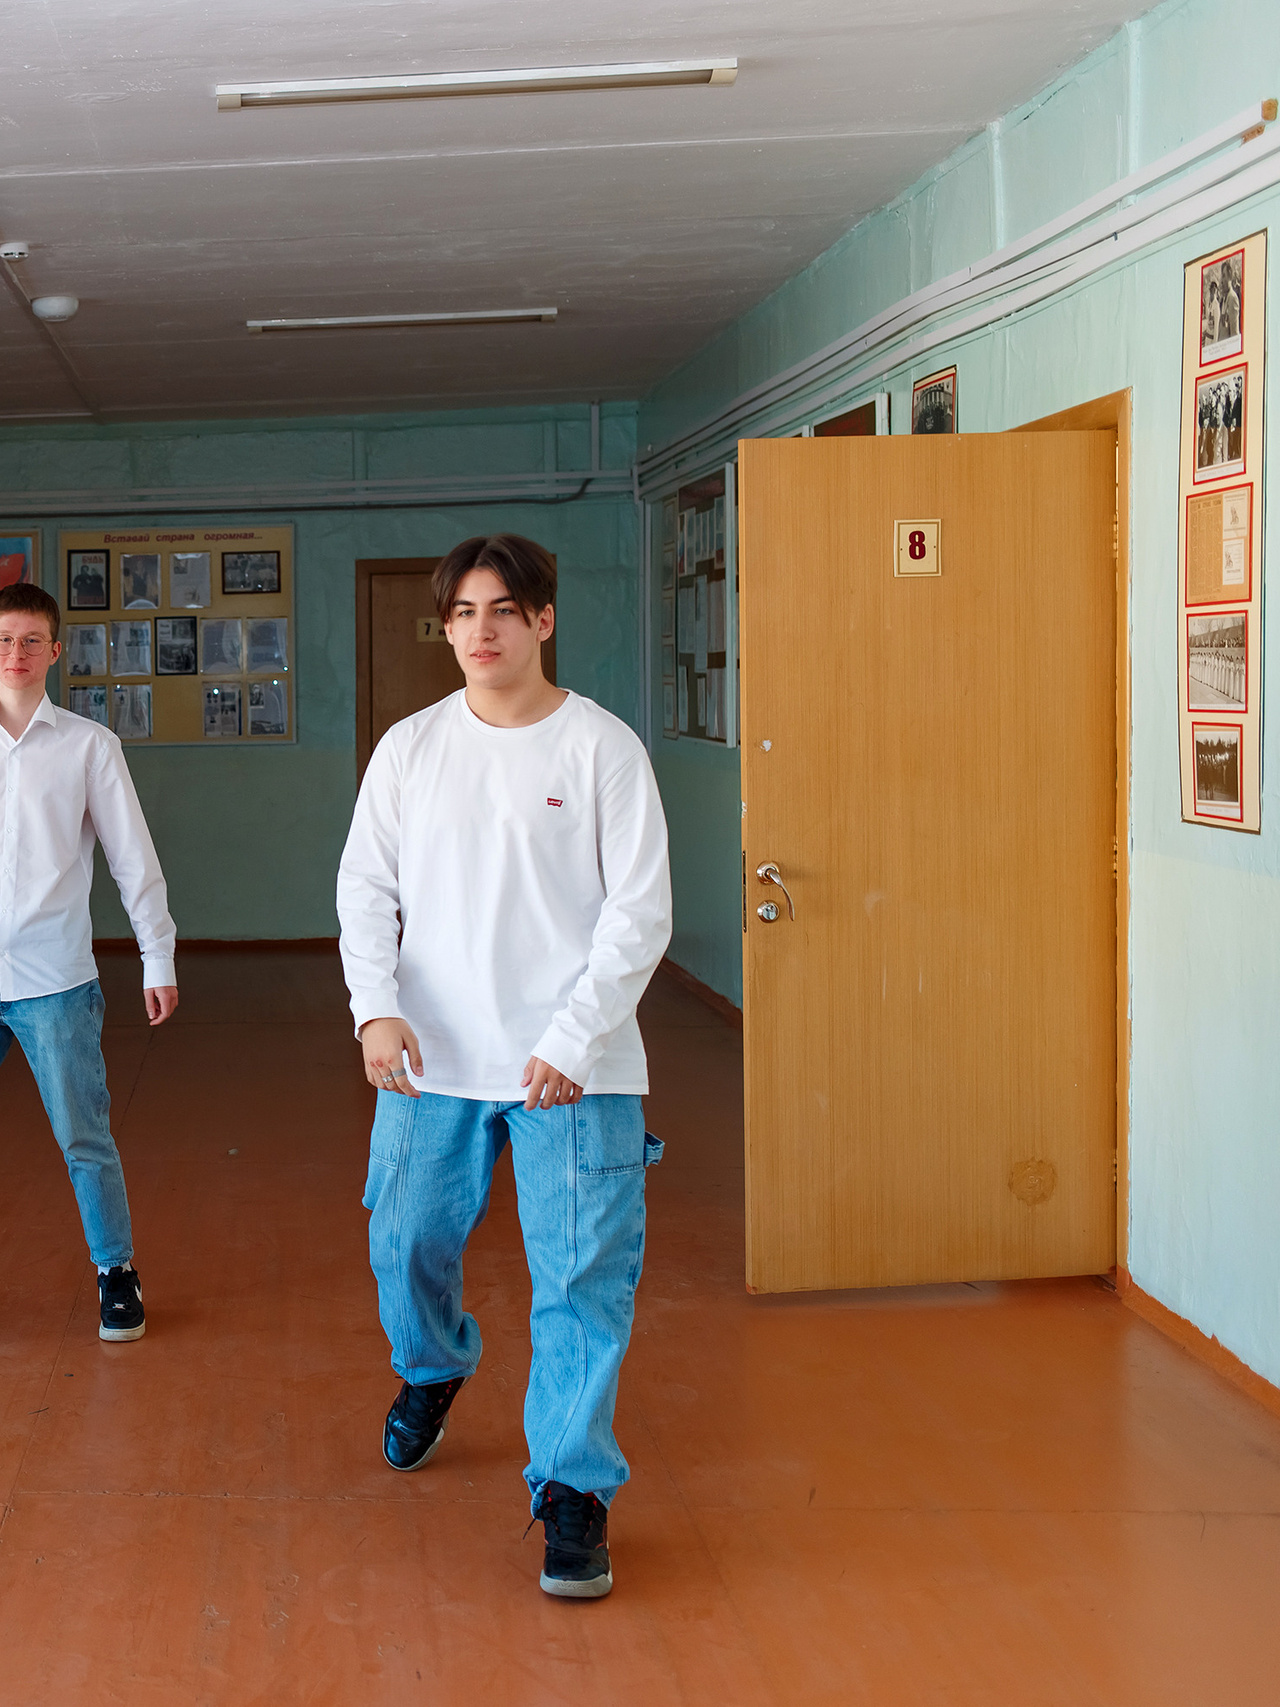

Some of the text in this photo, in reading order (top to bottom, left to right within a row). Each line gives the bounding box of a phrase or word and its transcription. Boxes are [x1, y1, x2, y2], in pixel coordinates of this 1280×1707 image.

[103, 533, 150, 543] Вставай
[156, 533, 195, 544] страна
[908, 530, 926, 560] 8
[424, 622, 431, 636] 7
